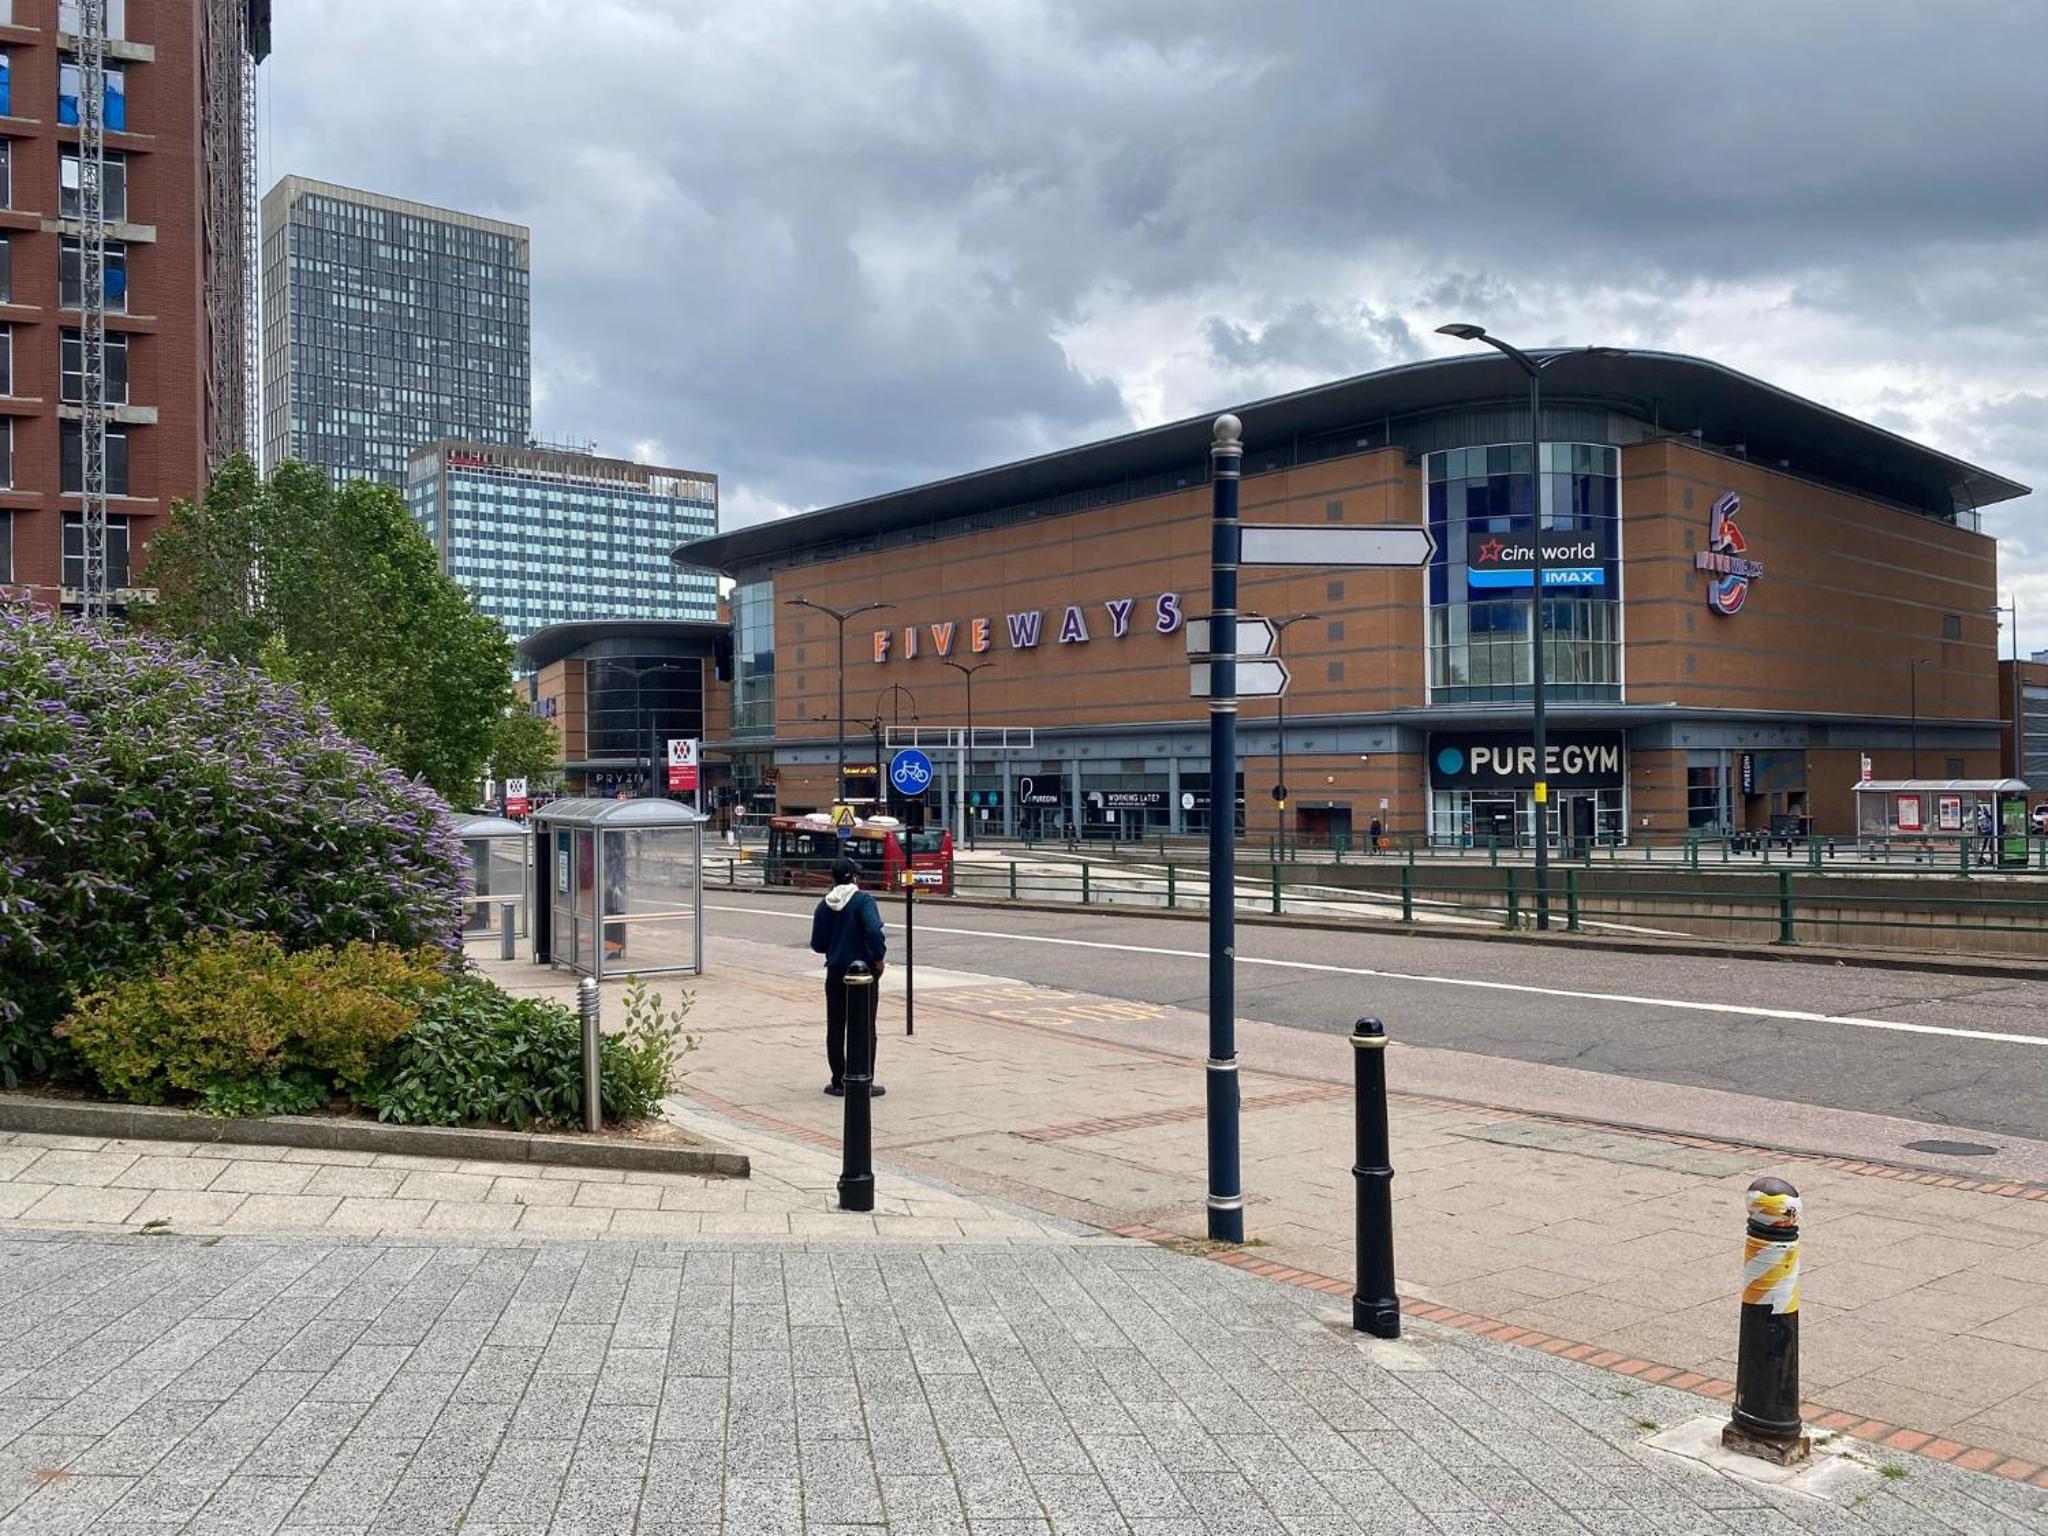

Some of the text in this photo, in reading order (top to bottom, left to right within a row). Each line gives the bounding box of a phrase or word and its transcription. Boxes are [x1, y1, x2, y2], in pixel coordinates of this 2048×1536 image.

[1500, 541, 1596, 561] cineworld
[1544, 572, 1595, 583] IMAX
[873, 592, 1183, 664] FIVE WAYS
[1469, 743, 1619, 777] PUREGYM
[1108, 793, 1160, 803] WORKING LATE?
